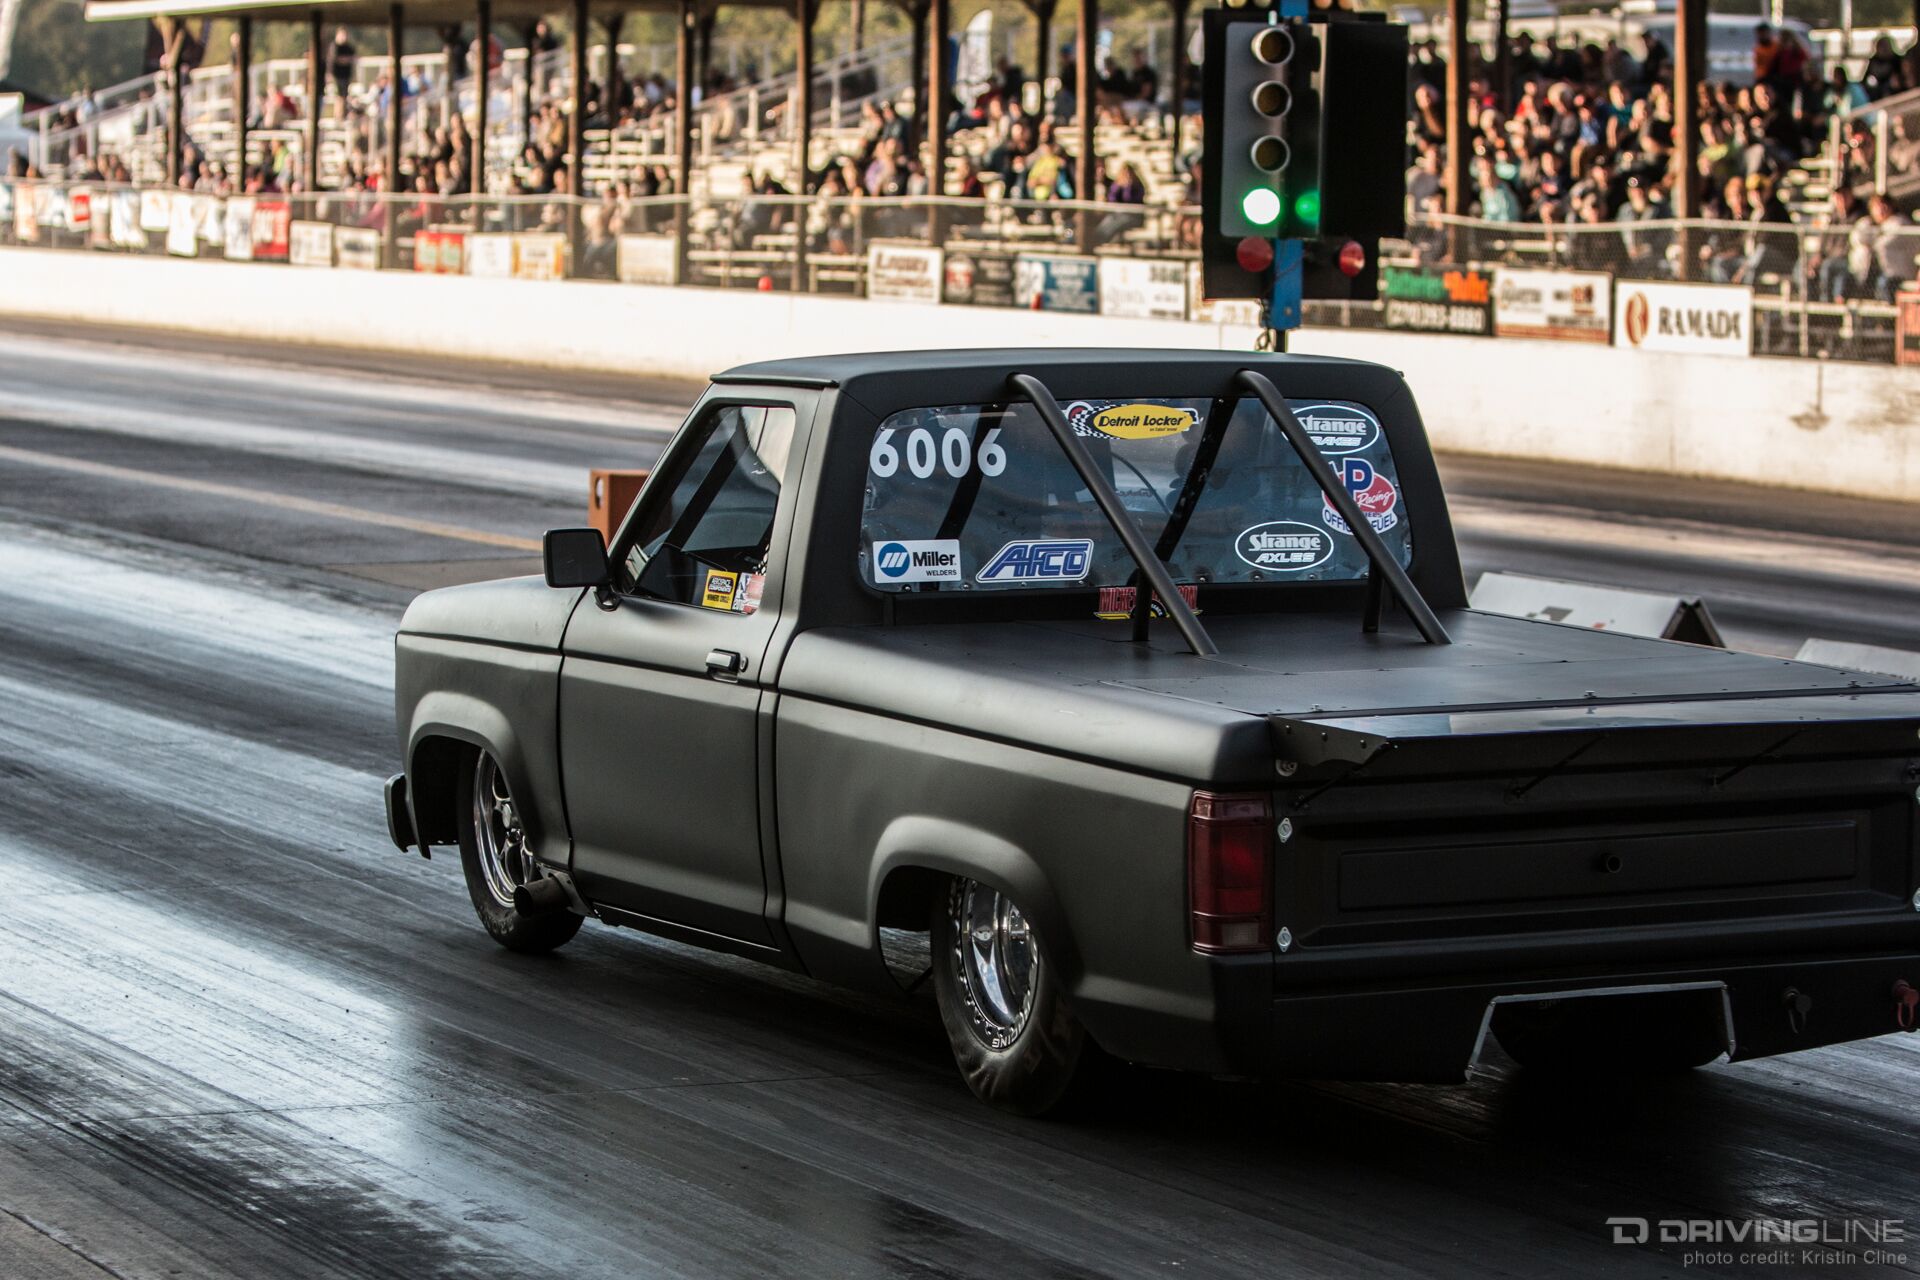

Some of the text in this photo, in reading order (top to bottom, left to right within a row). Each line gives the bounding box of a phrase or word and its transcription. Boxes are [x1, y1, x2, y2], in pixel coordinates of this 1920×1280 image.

[1098, 415, 1184, 427] Detroit Locker
[869, 427, 1007, 479] 6006
[1356, 490, 1395, 509] Racing
[1248, 531, 1321, 551] Strange
[912, 551, 956, 567] Miller
[1255, 552, 1316, 563] AXLES
